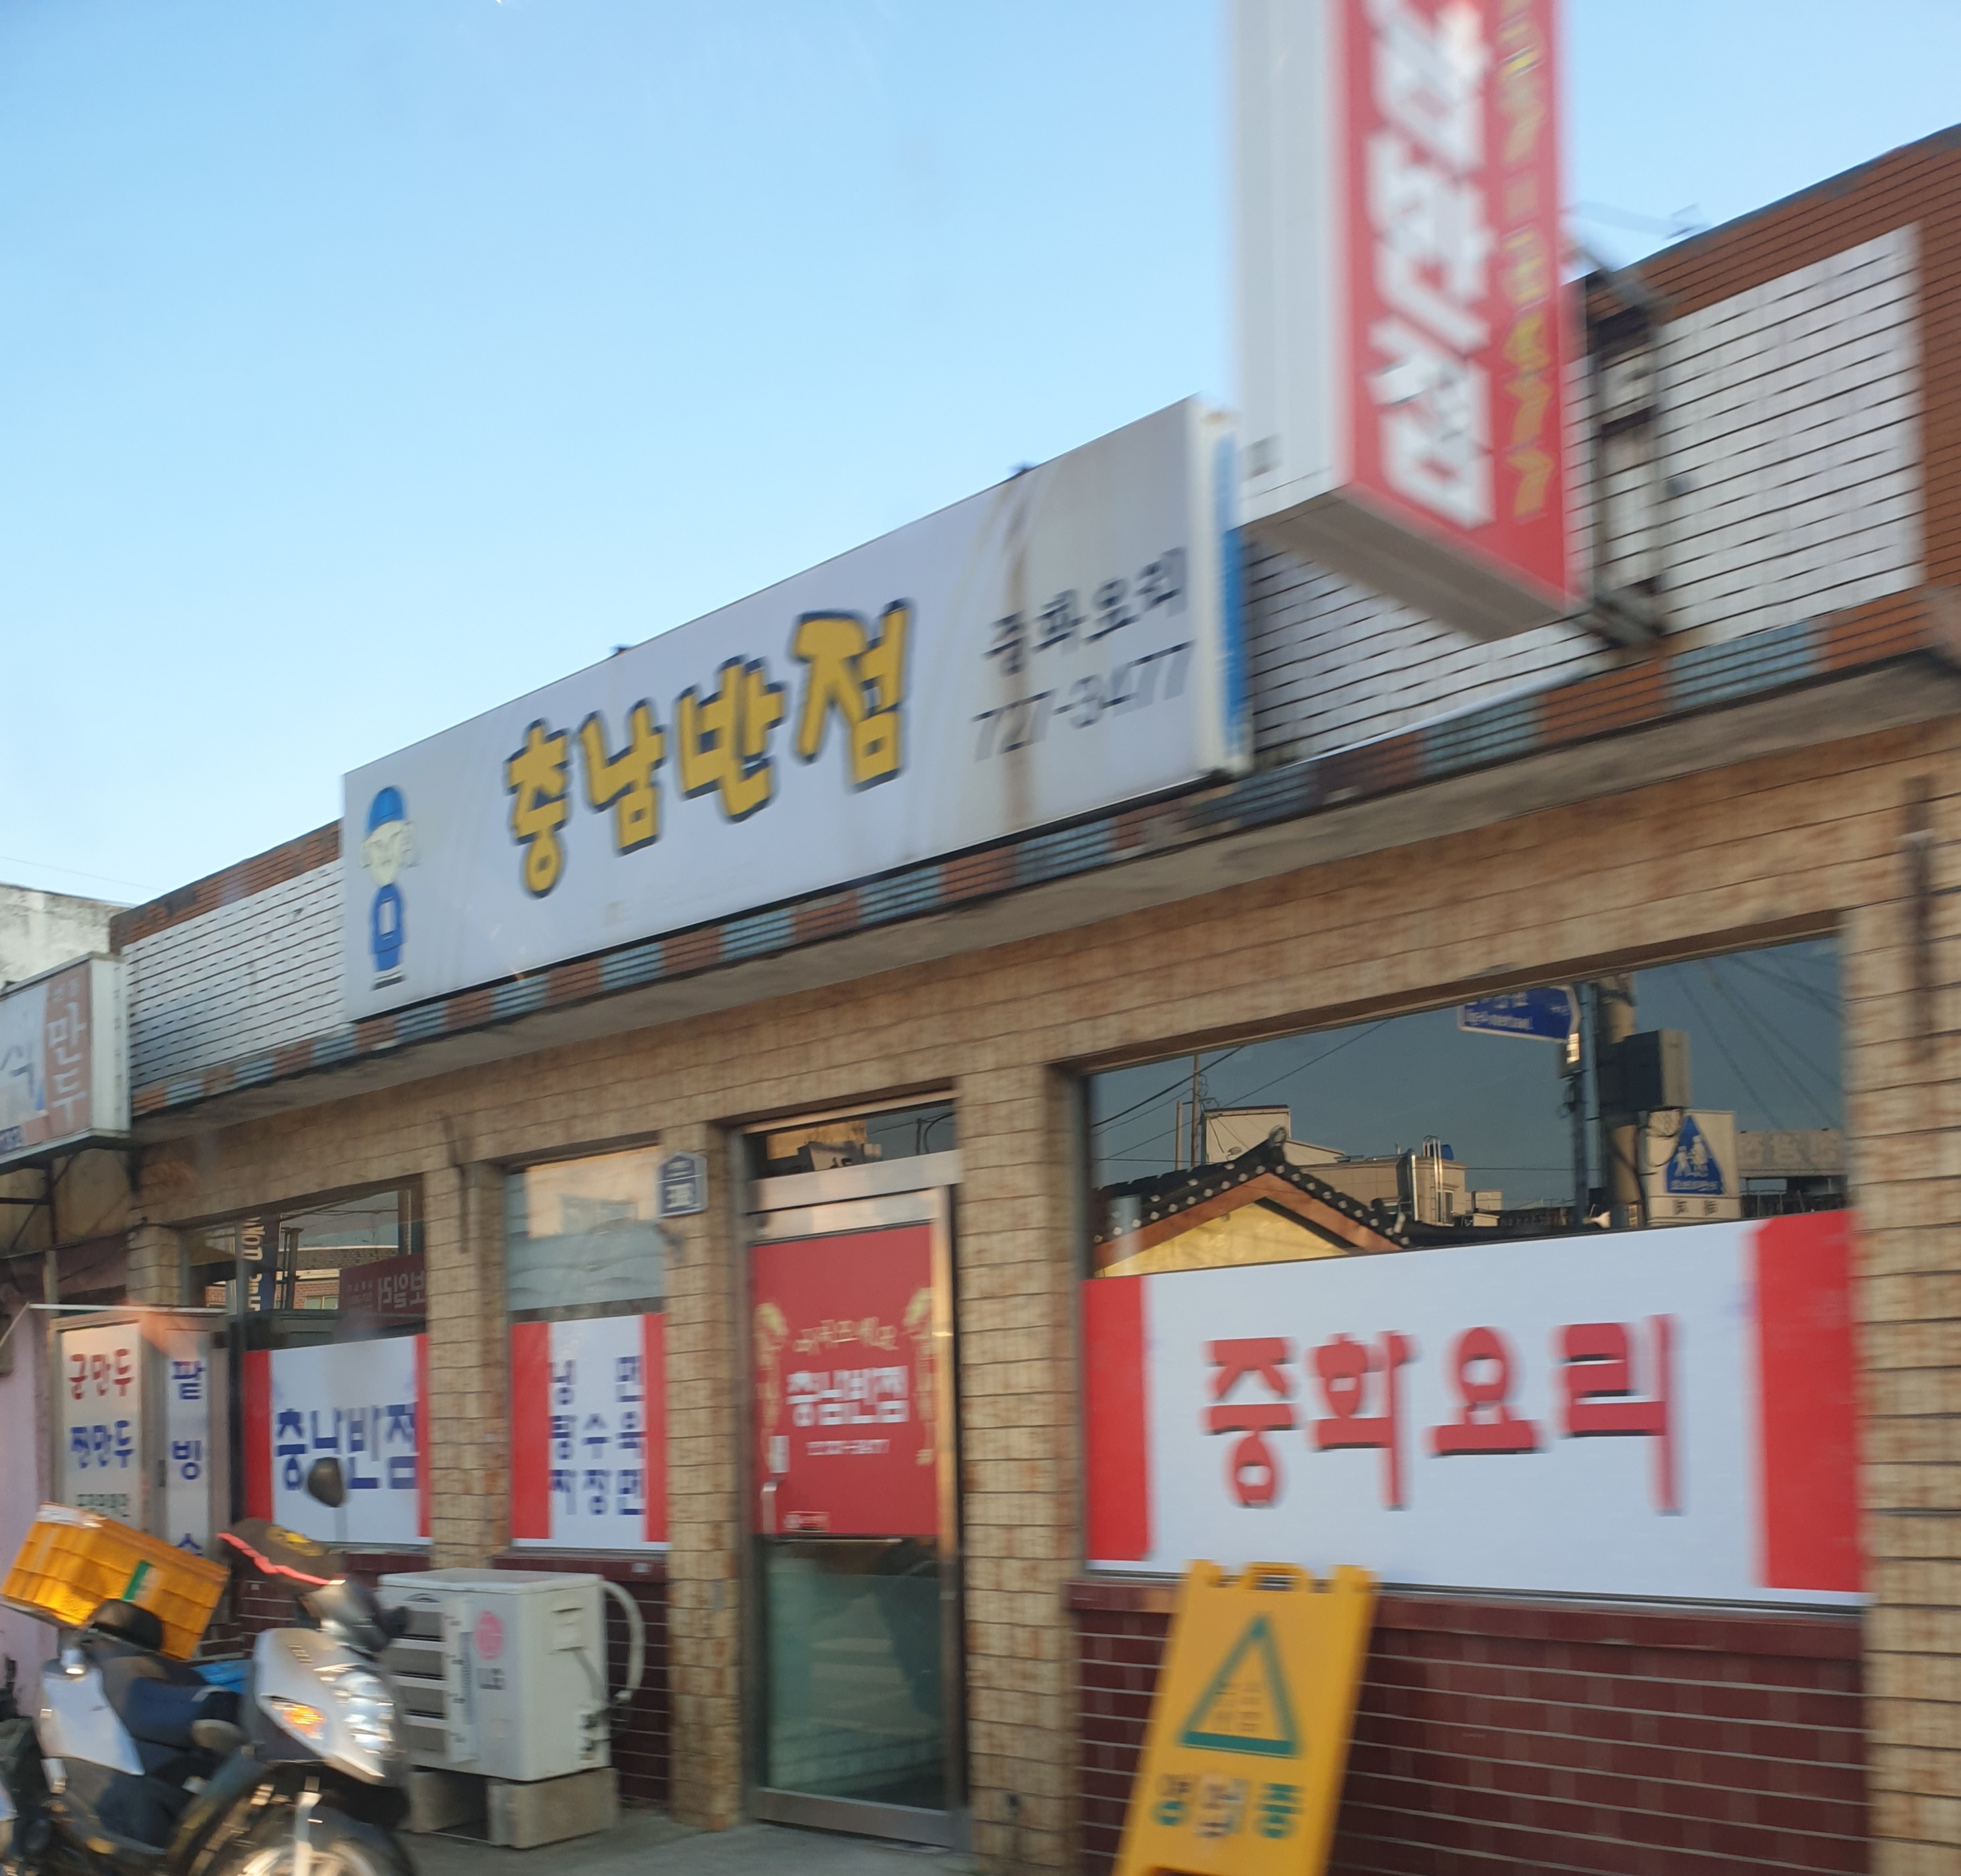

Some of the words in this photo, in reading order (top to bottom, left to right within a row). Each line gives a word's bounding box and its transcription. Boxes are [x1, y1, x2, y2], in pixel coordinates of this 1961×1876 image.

[980, 546, 1187, 677] 중화요리
[503, 597, 913, 899] 충남반점
[969, 638, 1197, 762] 727-3477
[46, 1001, 87, 1129] 만두
[786, 1365, 909, 1427] 충남반점
[1201, 1313, 1683, 1516] 중화요리
